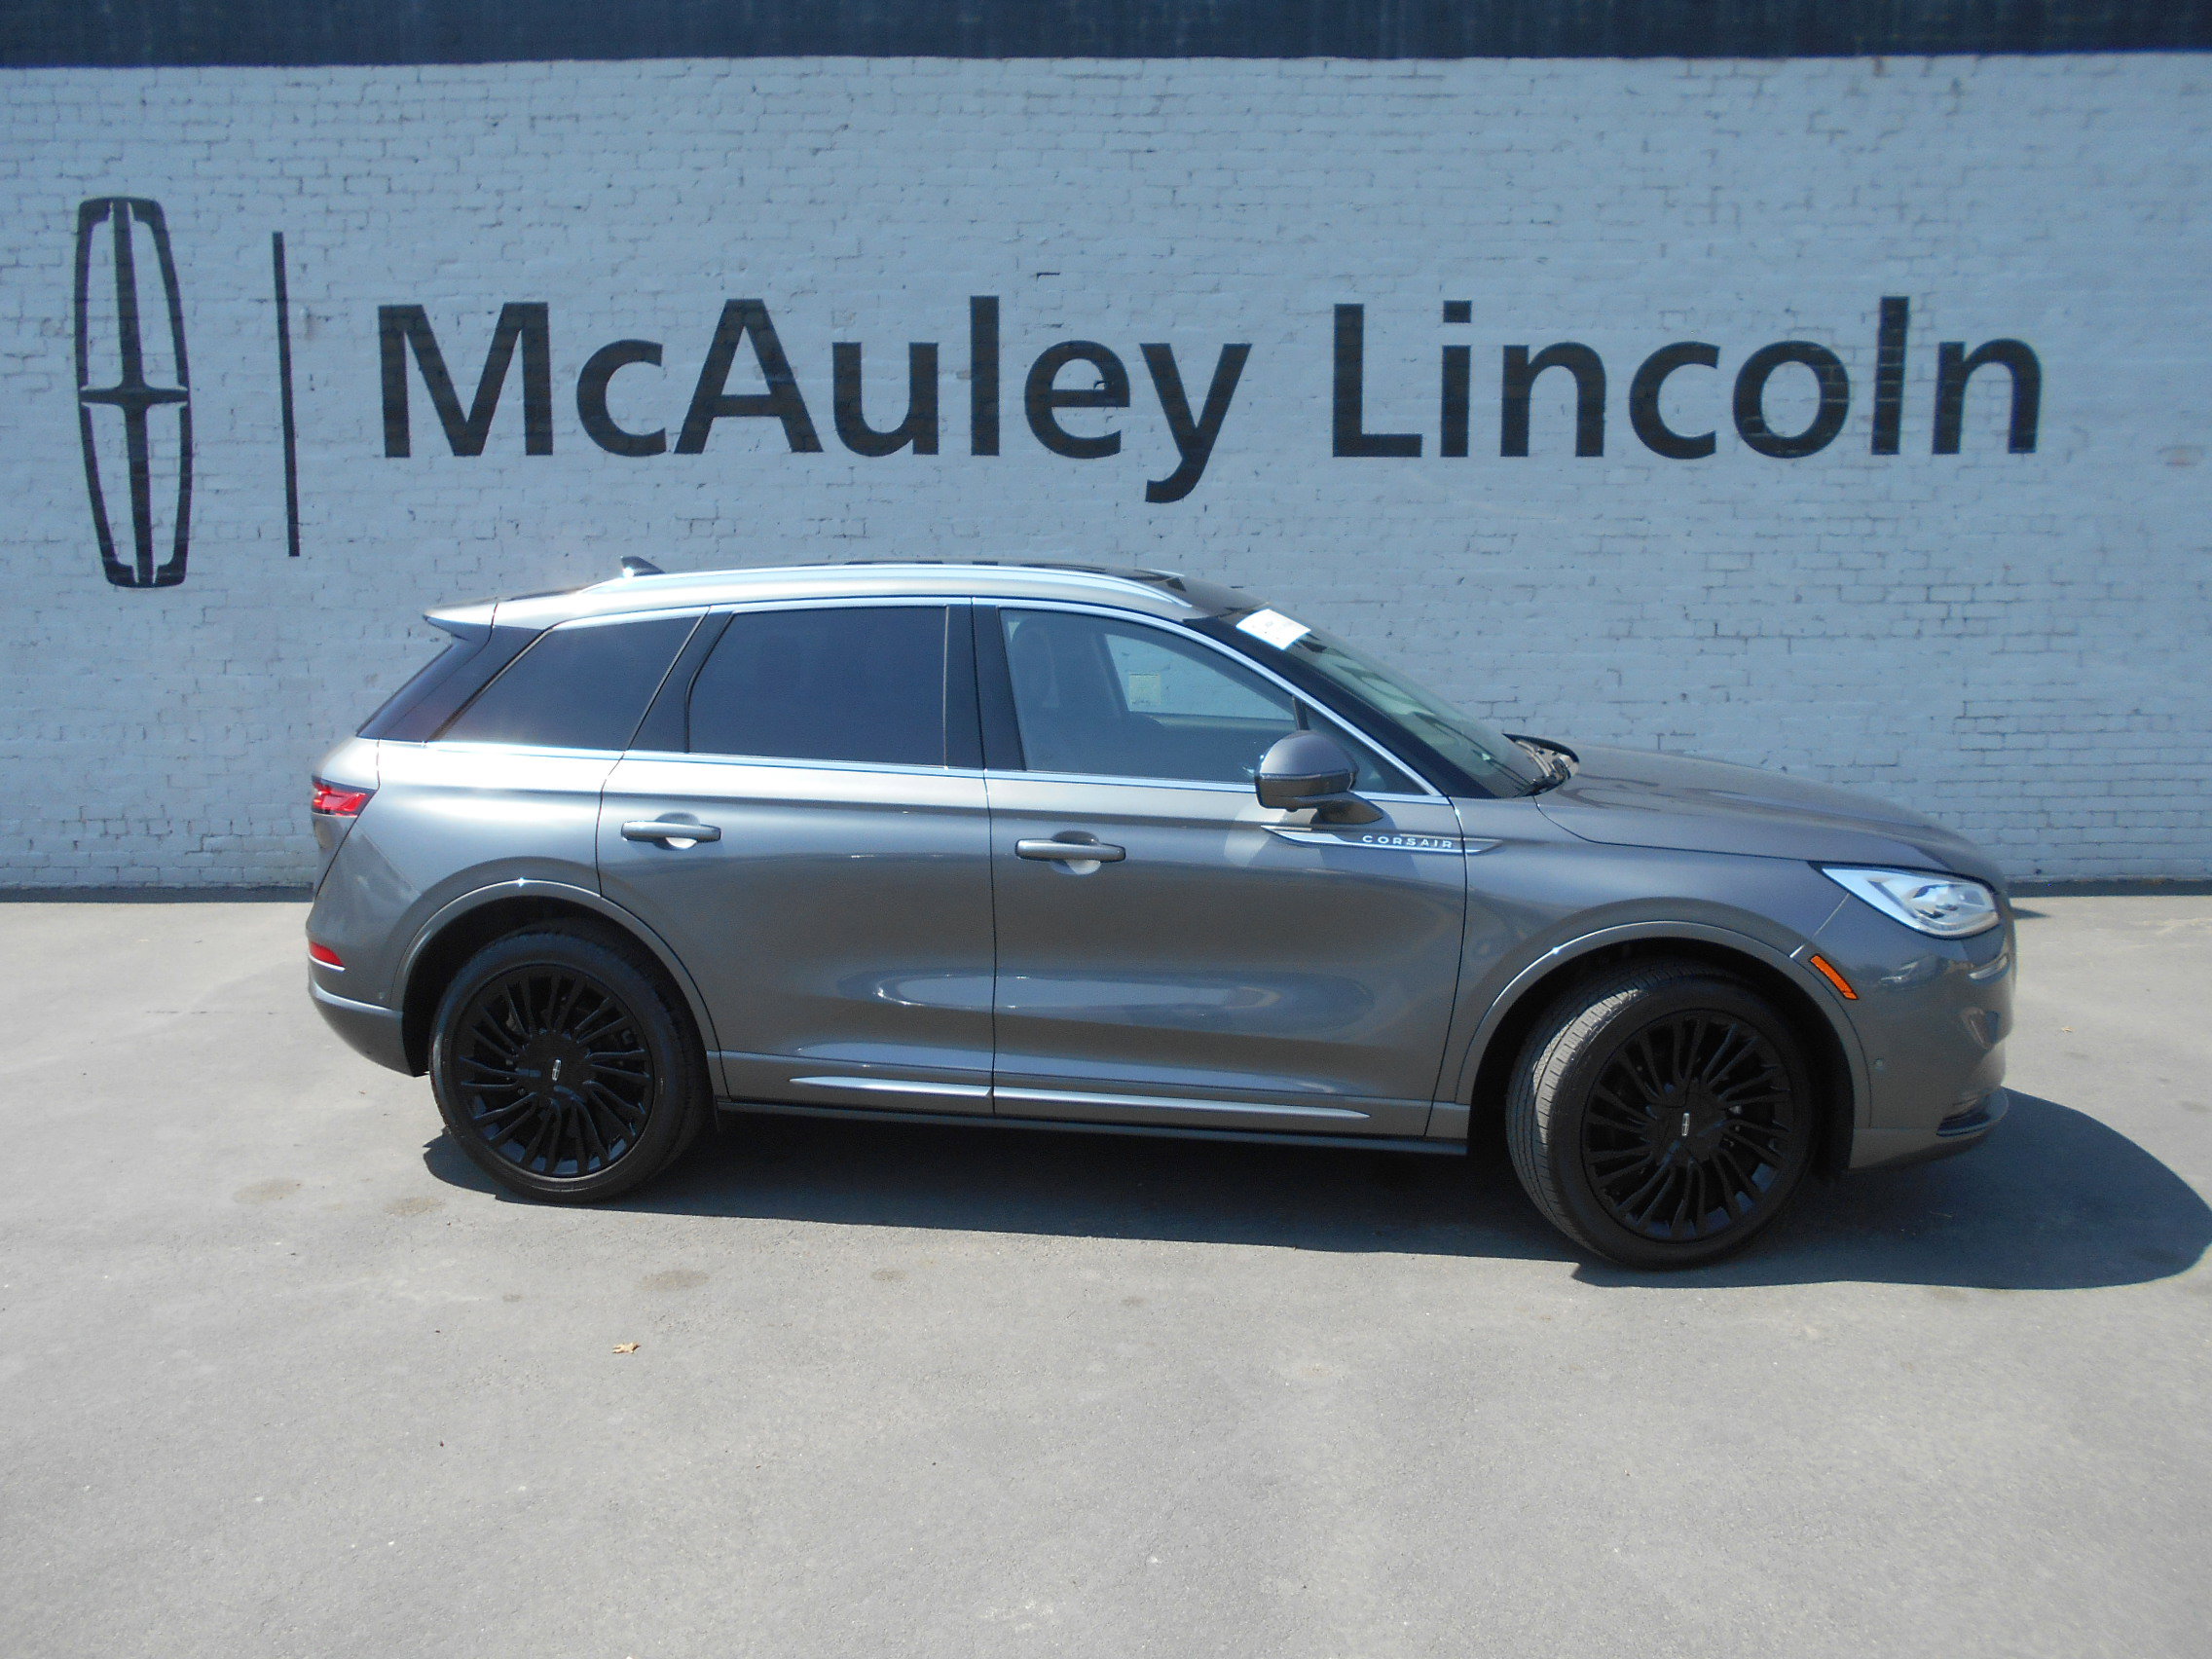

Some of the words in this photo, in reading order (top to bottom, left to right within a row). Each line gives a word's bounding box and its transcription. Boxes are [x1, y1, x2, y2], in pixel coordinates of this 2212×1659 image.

[378, 296, 1251, 503] McAuley
[1333, 296, 2042, 460] Lincoln
[1362, 834, 1453, 848] CORSAIR
